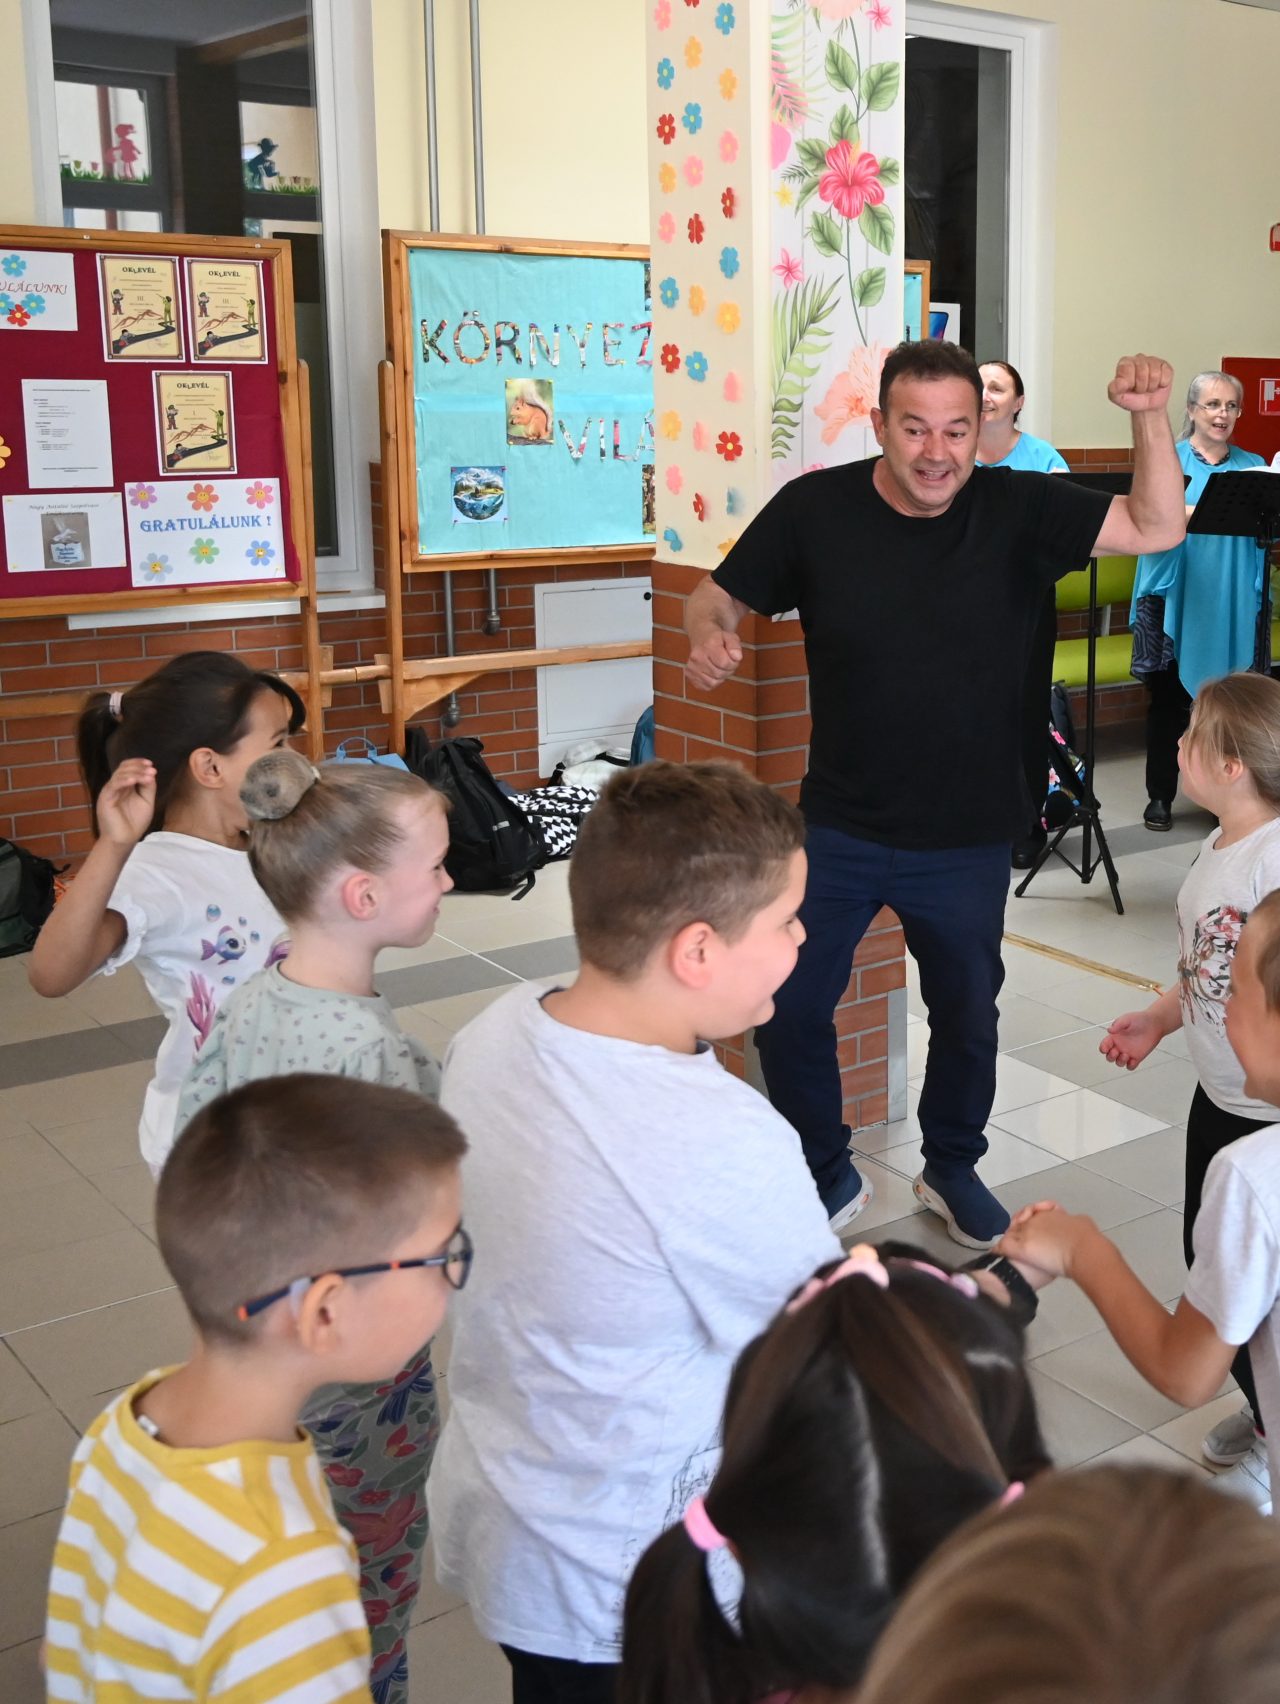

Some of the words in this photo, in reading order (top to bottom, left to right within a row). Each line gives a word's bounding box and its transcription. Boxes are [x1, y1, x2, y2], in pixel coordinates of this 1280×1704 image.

[122, 266, 157, 274] OKLEVÉL
[208, 270, 241, 278] OKLEVÉL
[176, 382, 210, 390] OKLEVÉL
[139, 514, 262, 533] GRATULÁLUNK
[265, 515, 272, 527] !
